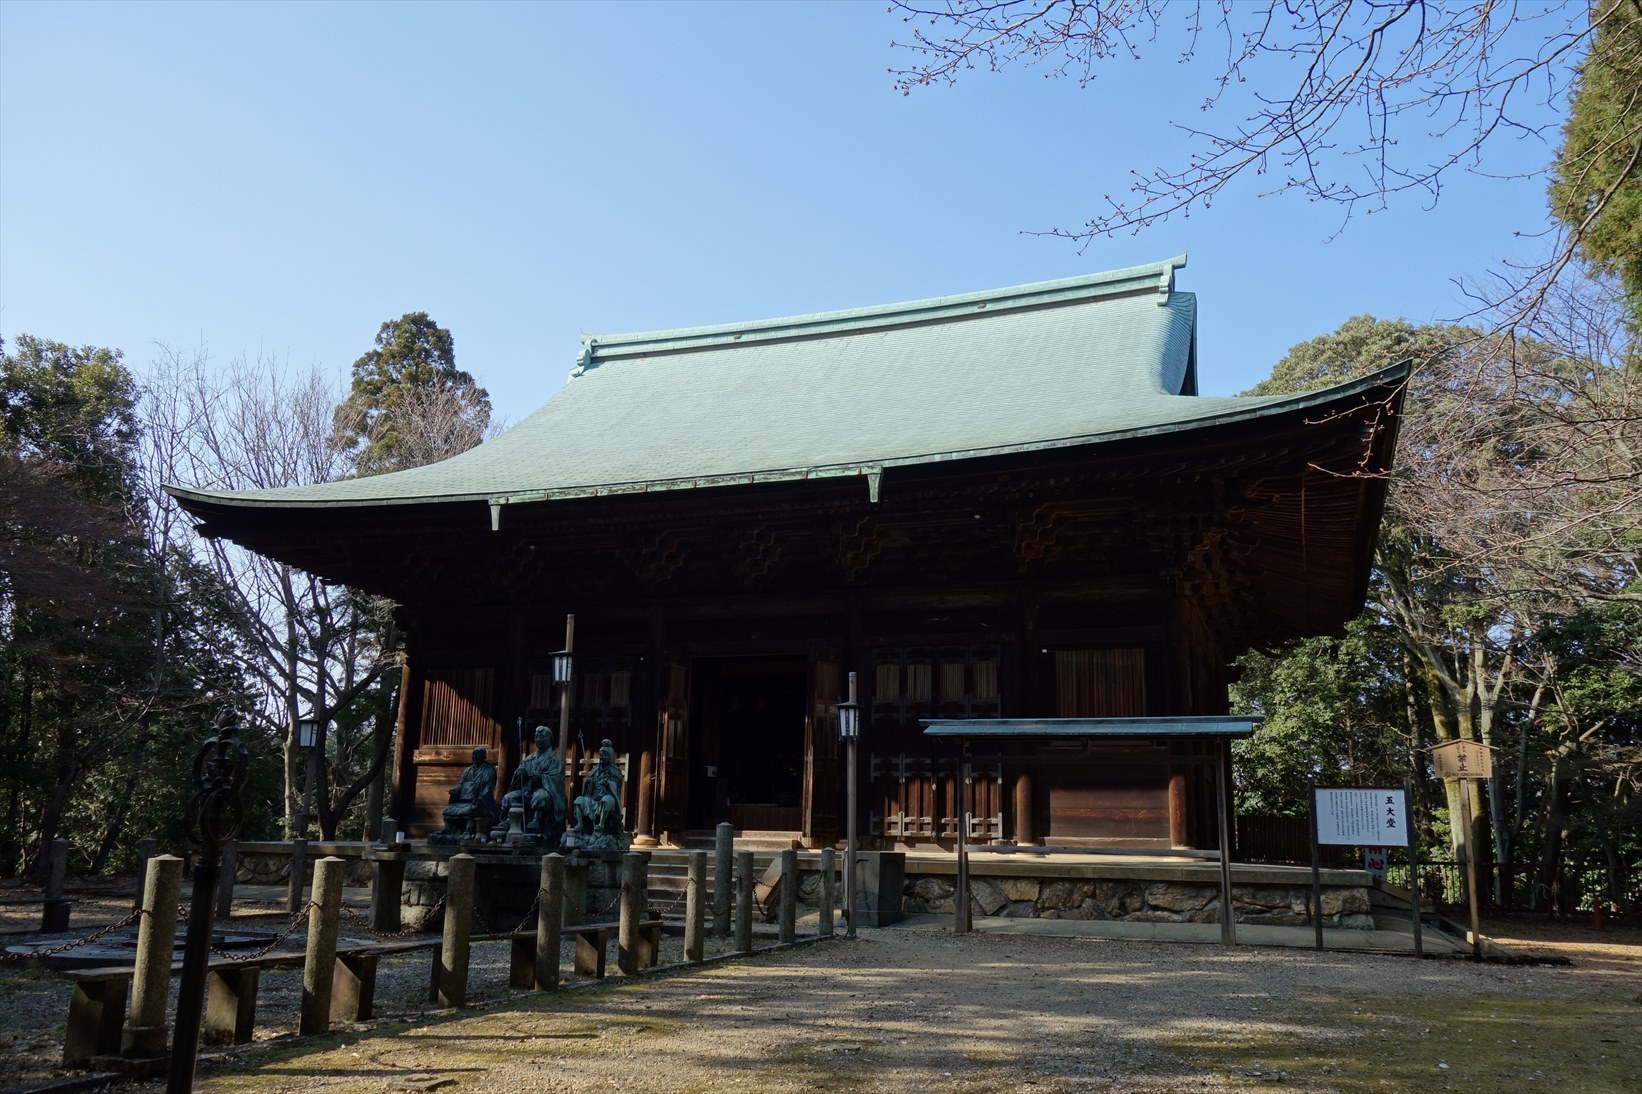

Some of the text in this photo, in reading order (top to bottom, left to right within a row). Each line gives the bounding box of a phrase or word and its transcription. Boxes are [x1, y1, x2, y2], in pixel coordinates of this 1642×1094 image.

[1457, 753, 1468, 772] 禁止
[1385, 796, 1396, 829] 五大堂
